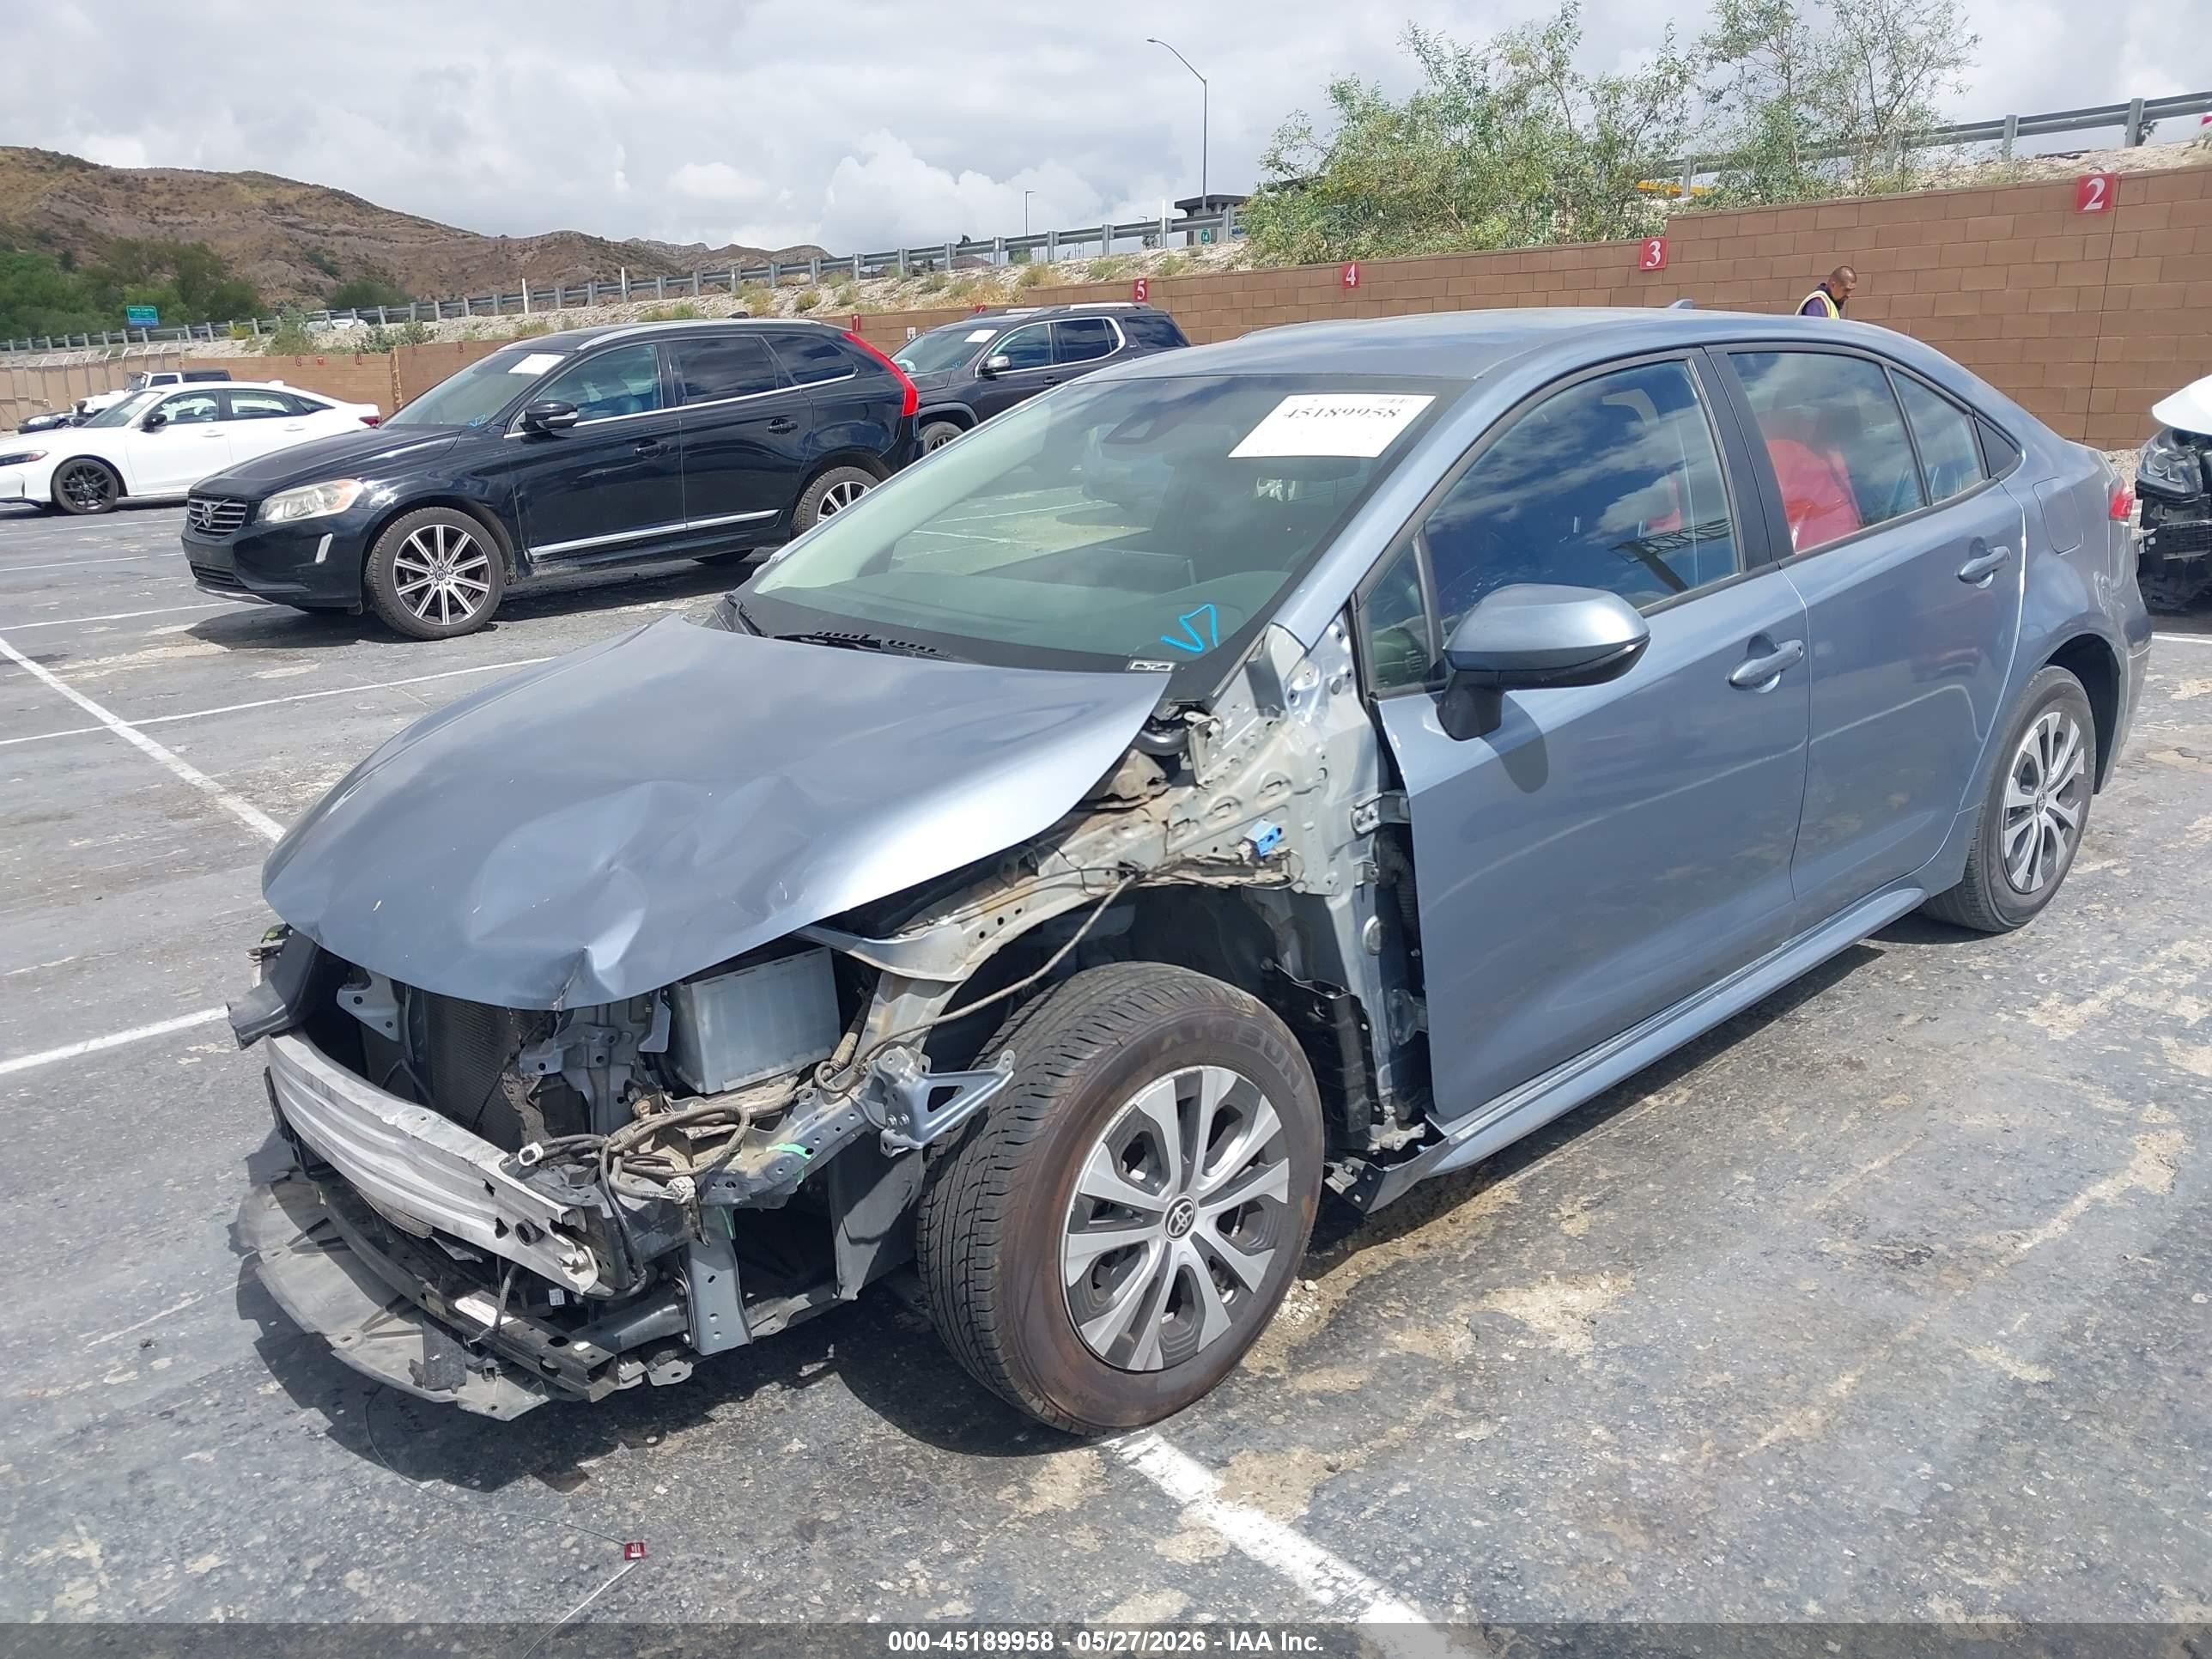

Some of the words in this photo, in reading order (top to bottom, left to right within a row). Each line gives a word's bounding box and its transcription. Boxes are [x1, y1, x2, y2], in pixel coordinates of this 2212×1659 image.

[2083, 177, 2105, 210] 2
[1646, 240, 1661, 266] 3
[1346, 263, 1357, 286] 4
[1137, 280, 1145, 300] 5
